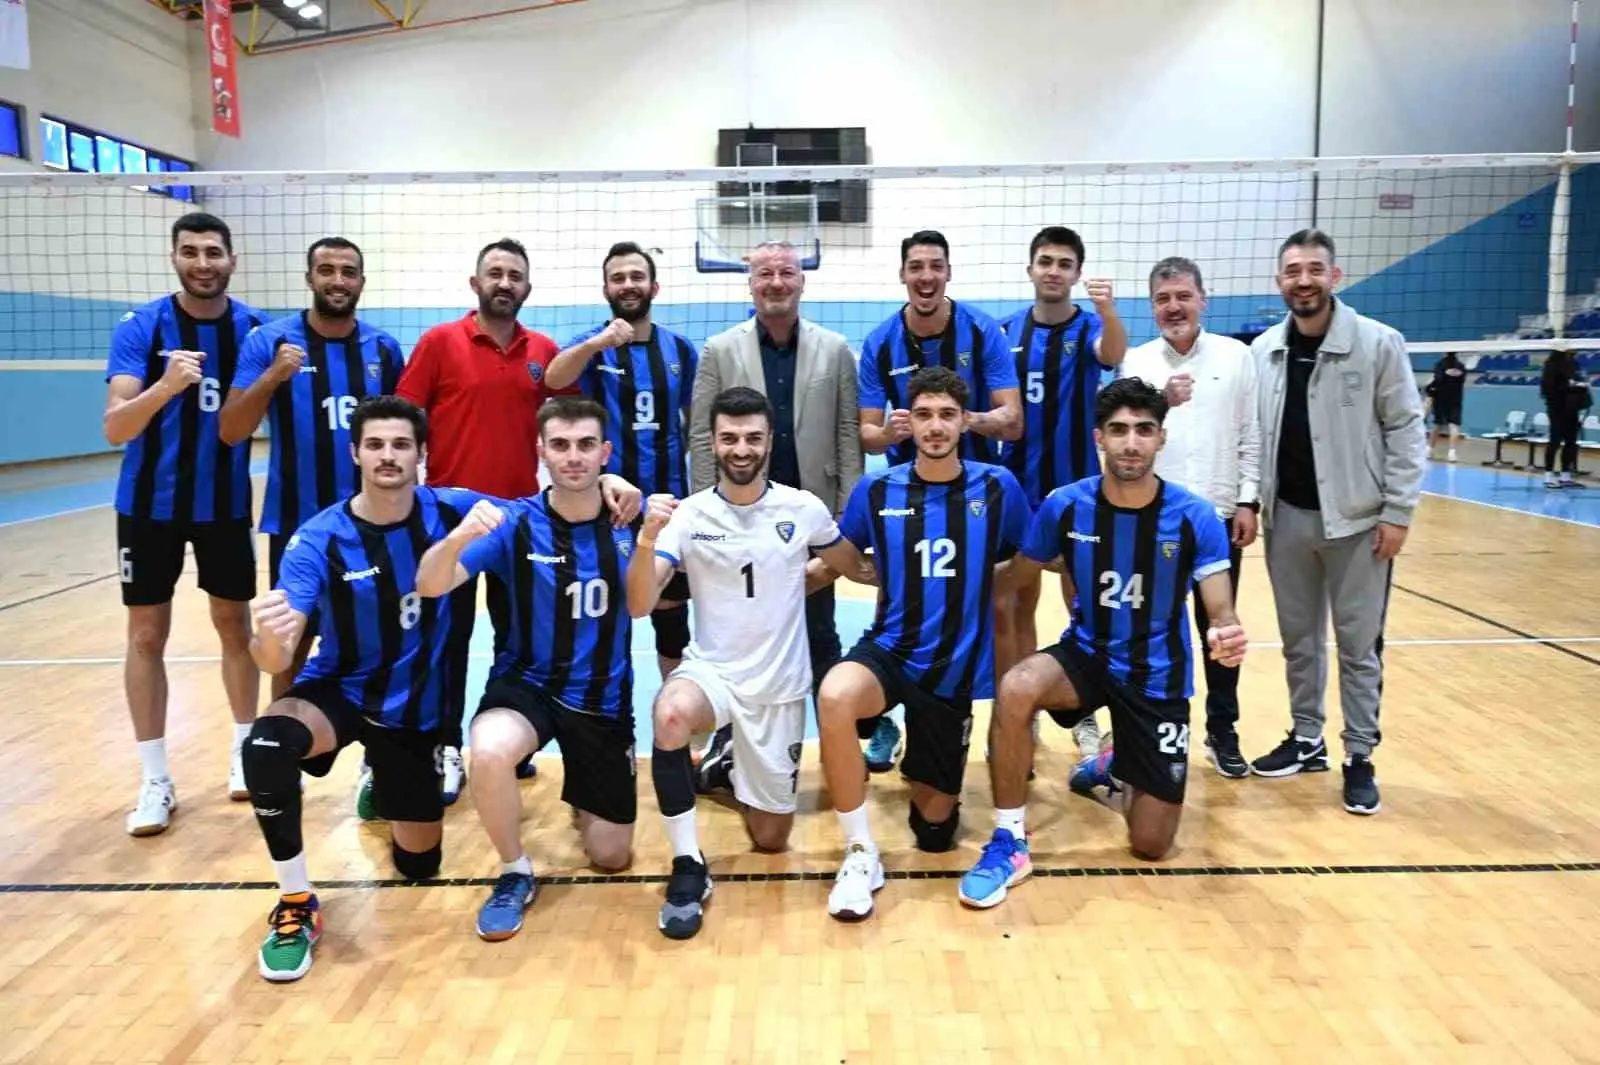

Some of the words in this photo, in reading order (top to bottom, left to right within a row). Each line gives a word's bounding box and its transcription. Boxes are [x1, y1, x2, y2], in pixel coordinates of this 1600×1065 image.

[199, 377, 221, 412] 6
[1026, 371, 1045, 403] 5
[322, 395, 359, 430] 16
[635, 391, 654, 422] 9
[691, 532, 727, 542] uhlsport
[914, 538, 957, 577] 12
[740, 562, 755, 598] 1
[1099, 571, 1144, 609] 24
[400, 591, 421, 630] 8
[565, 578, 609, 619] 10
[1157, 722, 1189, 753] 24
[791, 769, 798, 794] 1
